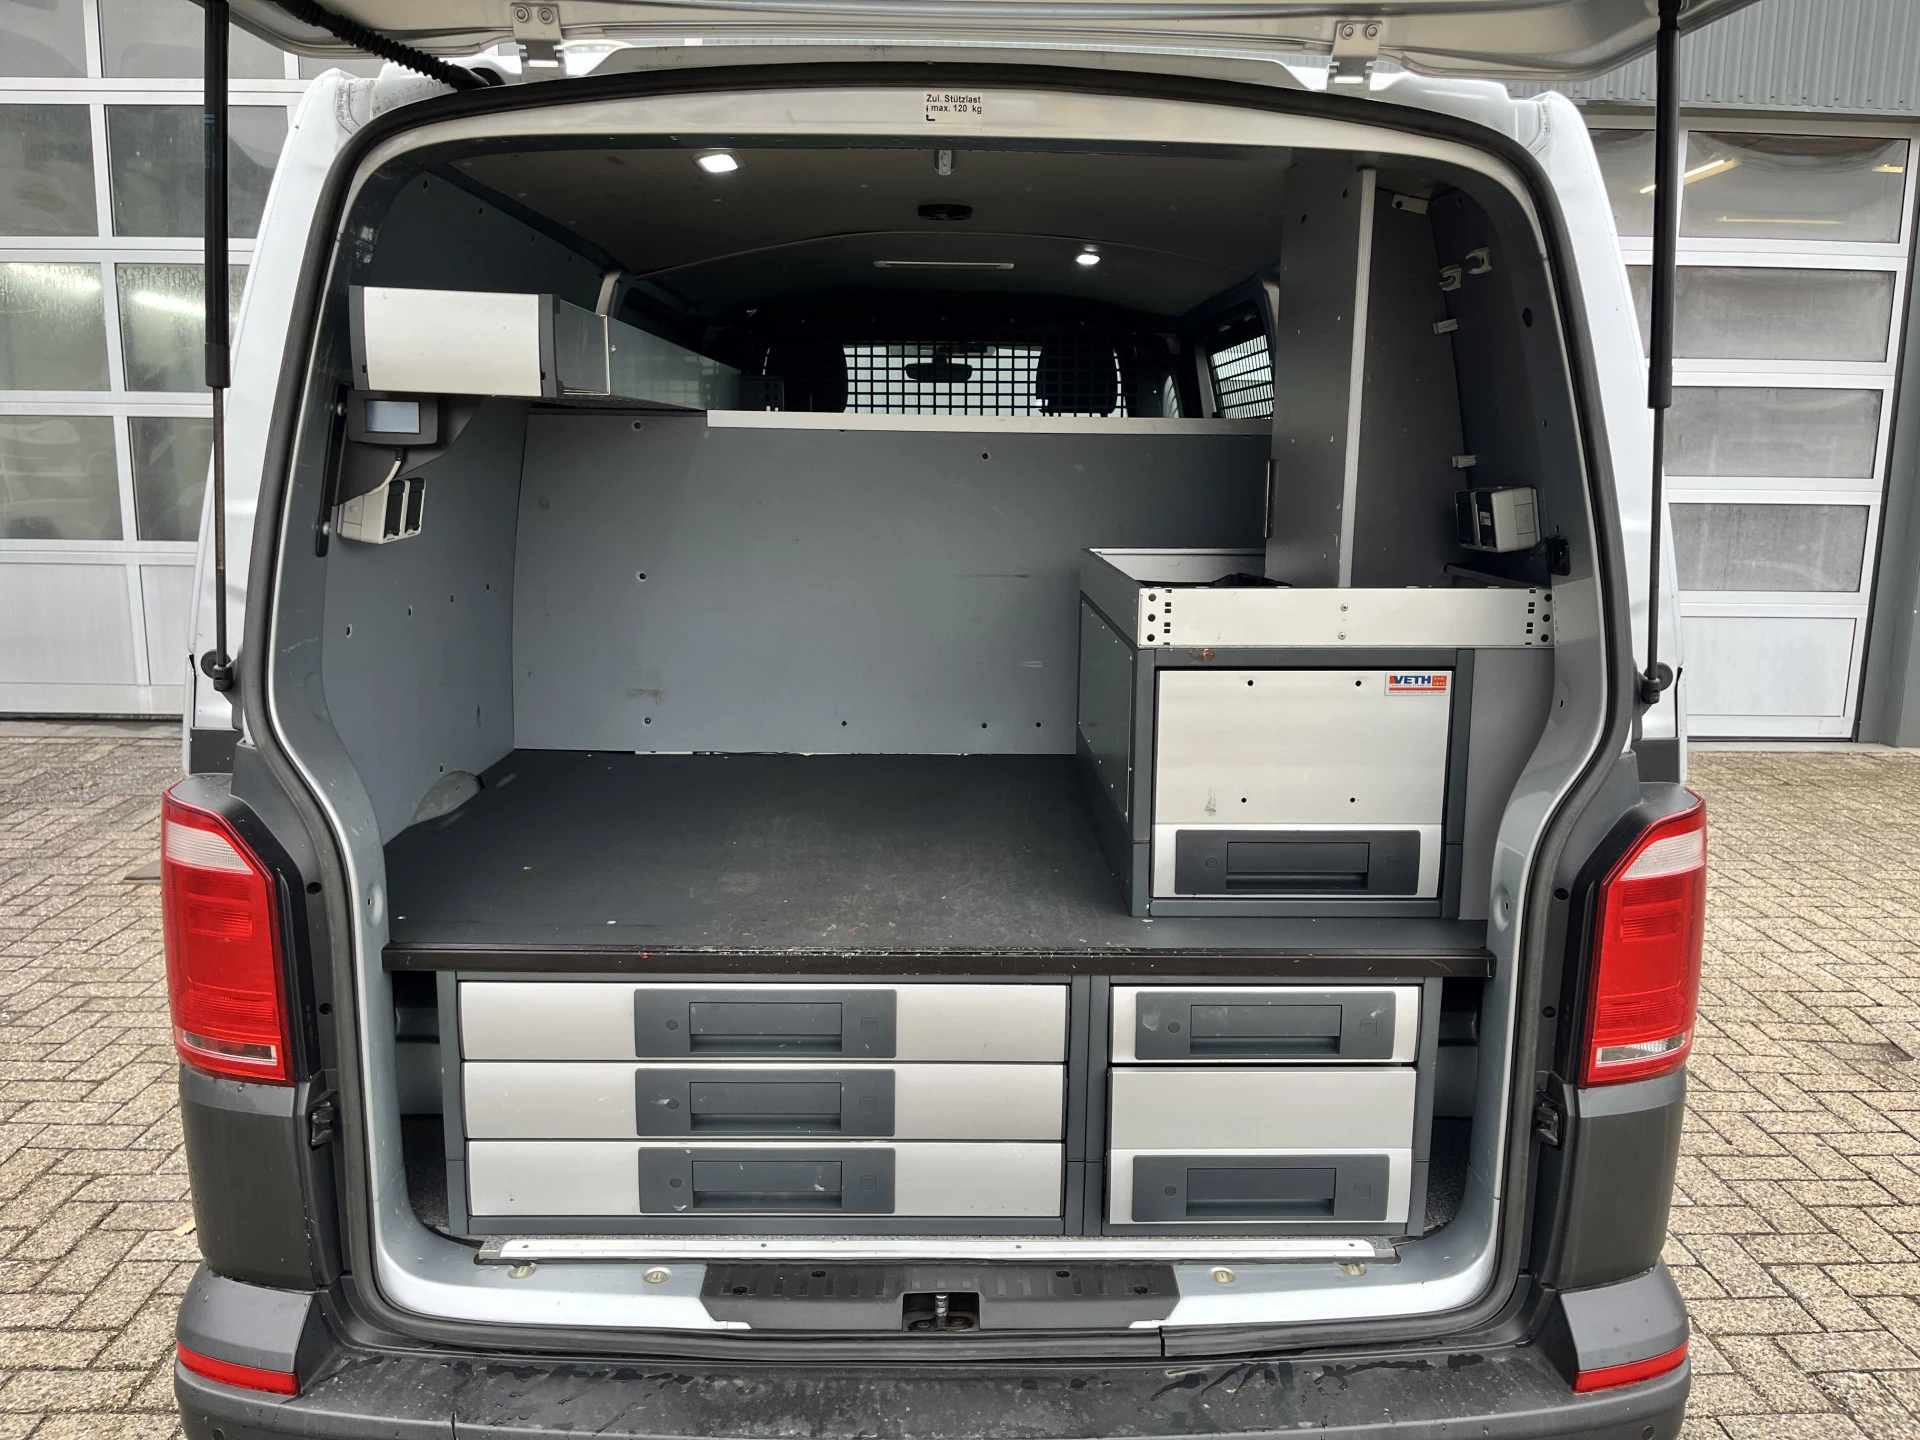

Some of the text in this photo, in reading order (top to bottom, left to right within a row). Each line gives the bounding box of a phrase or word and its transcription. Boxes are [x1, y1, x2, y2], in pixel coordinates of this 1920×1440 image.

[926, 94, 981, 104] Zul. Stützlast
[953, 104, 968, 112] 120
[972, 104, 982, 115] kg
[1394, 675, 1432, 684] VETH
